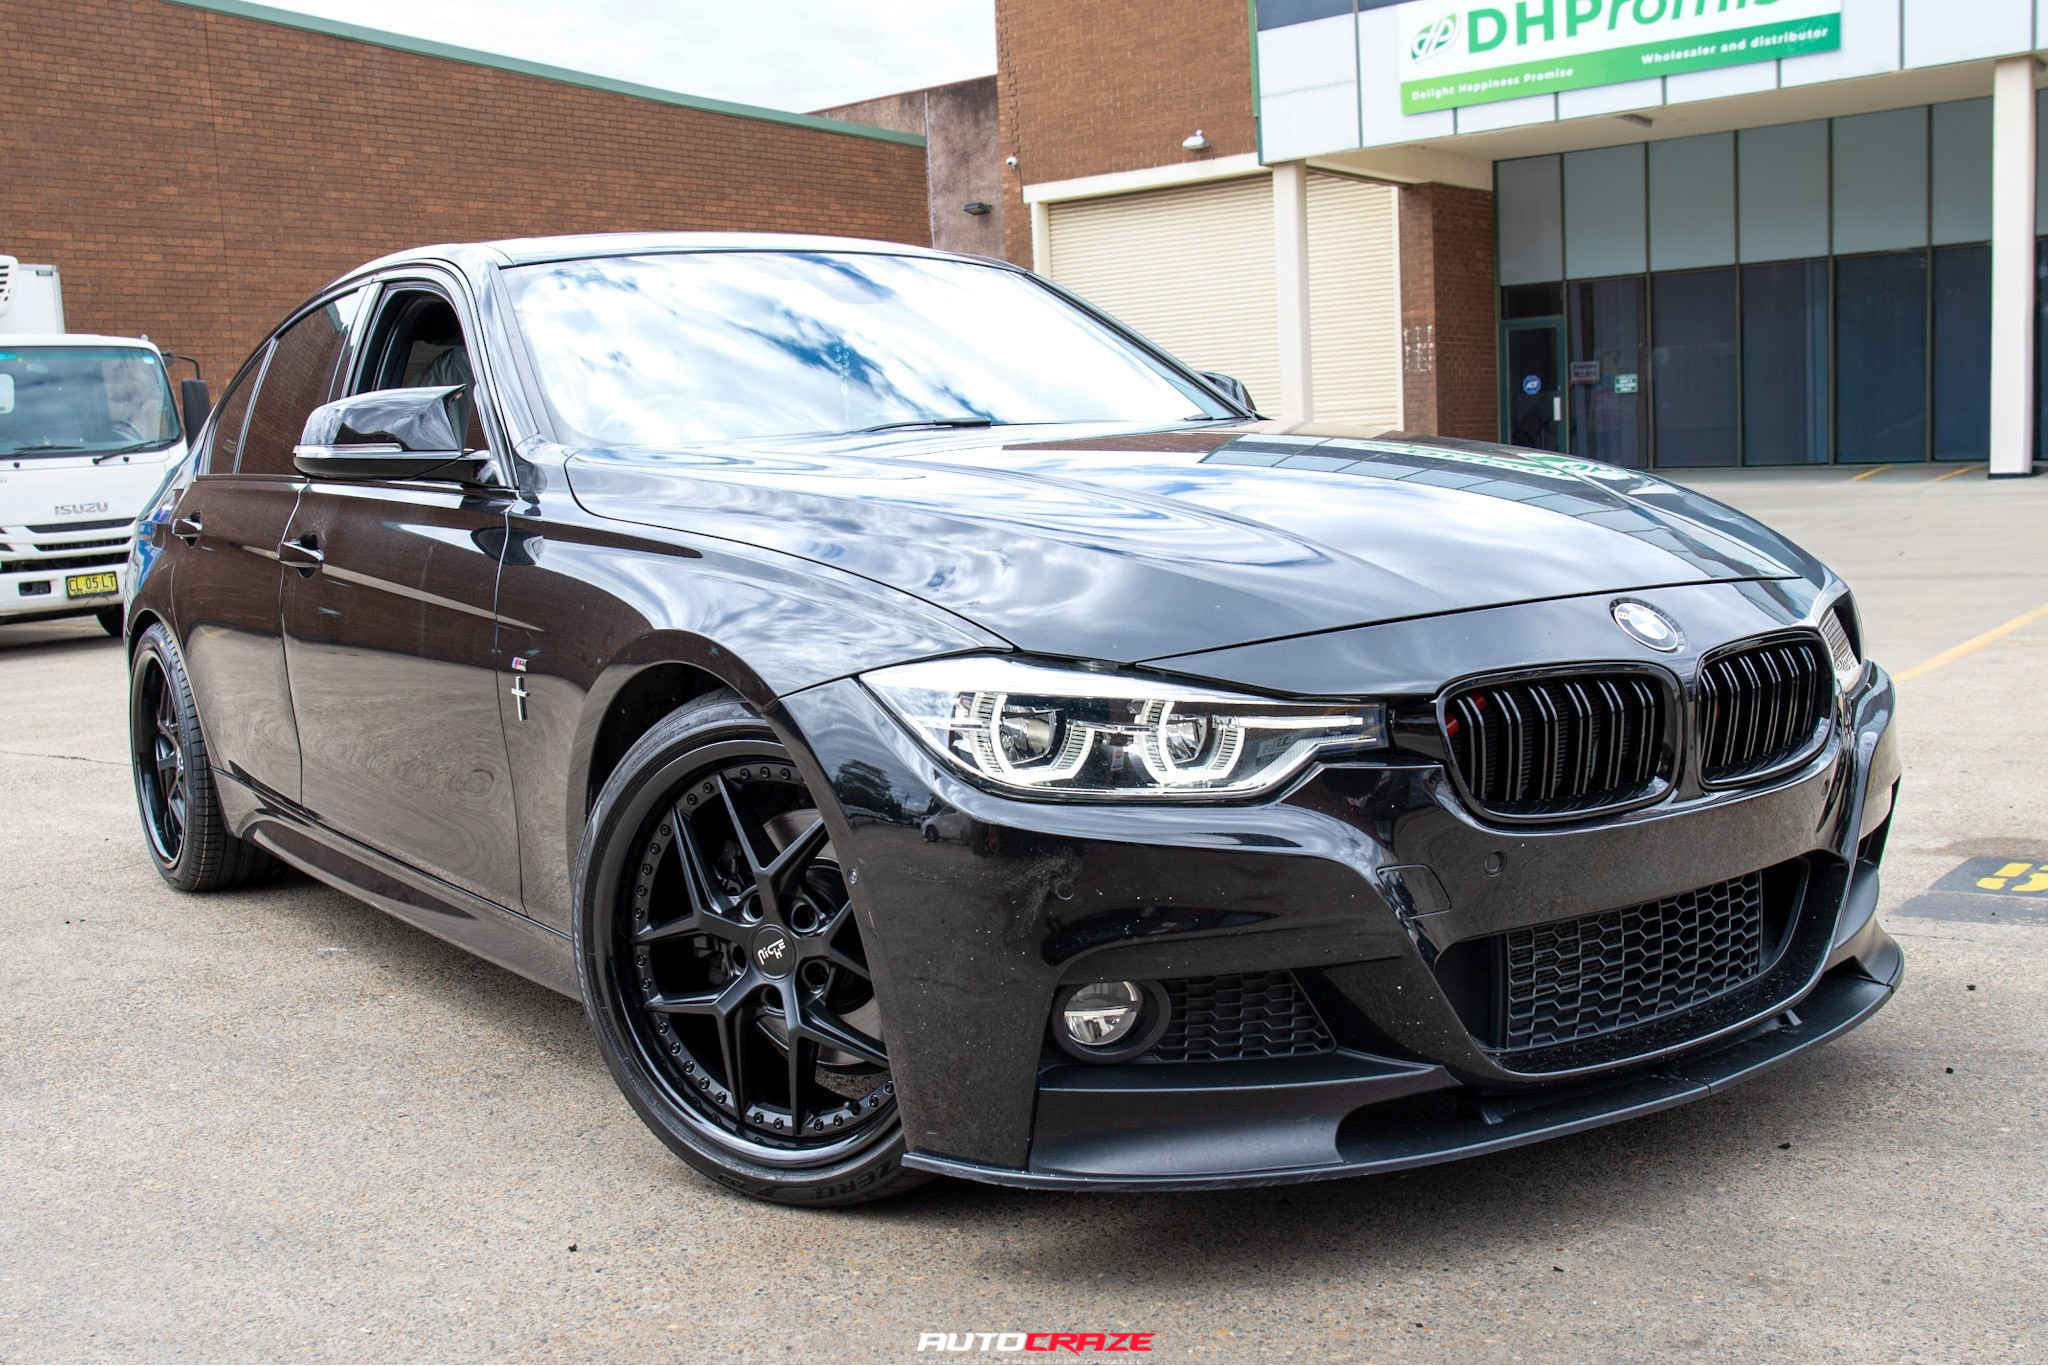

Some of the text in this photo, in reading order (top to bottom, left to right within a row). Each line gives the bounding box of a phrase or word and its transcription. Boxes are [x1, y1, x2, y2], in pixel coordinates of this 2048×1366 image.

[1641, 27, 1829, 65] Wholesaler and distributor
[1411, 67, 1574, 101] Delight Happiness Promise
[54, 502, 109, 516] ISUZU
